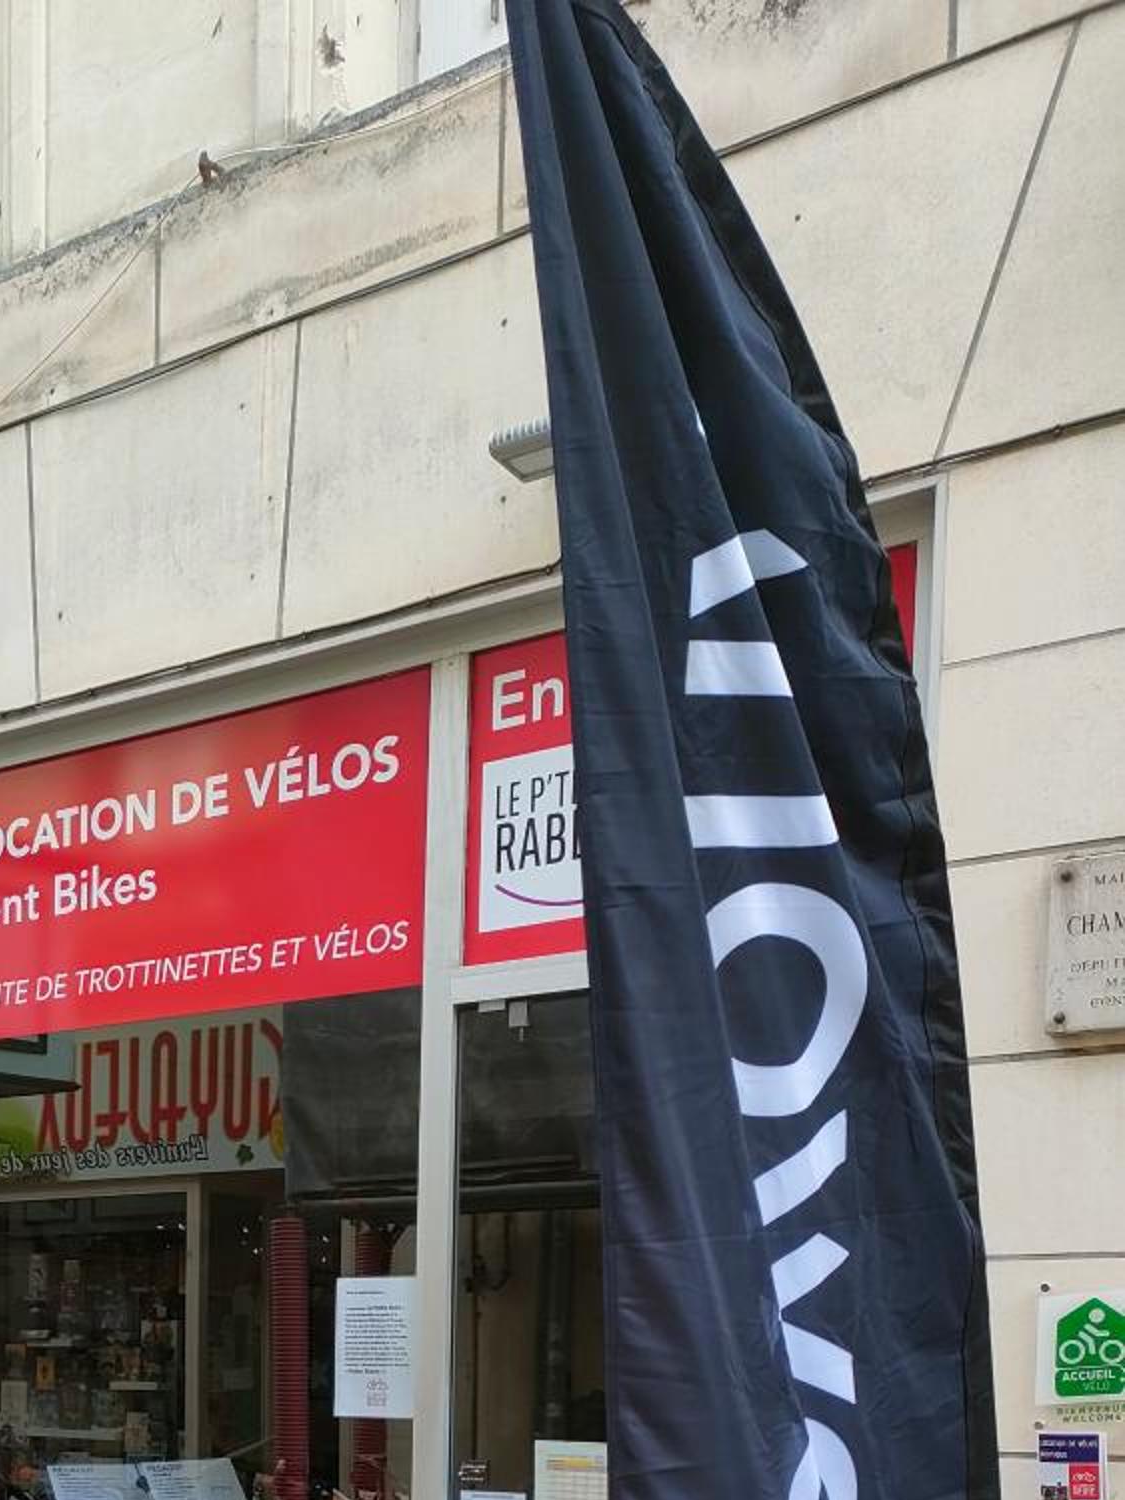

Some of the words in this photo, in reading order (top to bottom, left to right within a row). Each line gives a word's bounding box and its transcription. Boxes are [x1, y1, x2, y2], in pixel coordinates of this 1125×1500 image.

[492, 668, 564, 731] En
[172, 773, 229, 826] DE
[244, 735, 400, 810] VÉLOS
[496, 781, 521, 820] LE
[529, 771, 575, 812] P'T
[53, 864, 158, 917] Bikes
[35, 973, 67, 1001] DE
[76, 943, 262, 996] TROTTINETTES
[271, 937, 306, 969] ET
[314, 920, 410, 961] VÉLOS
[1062, 1369, 1116, 1381] ACCUEIL
